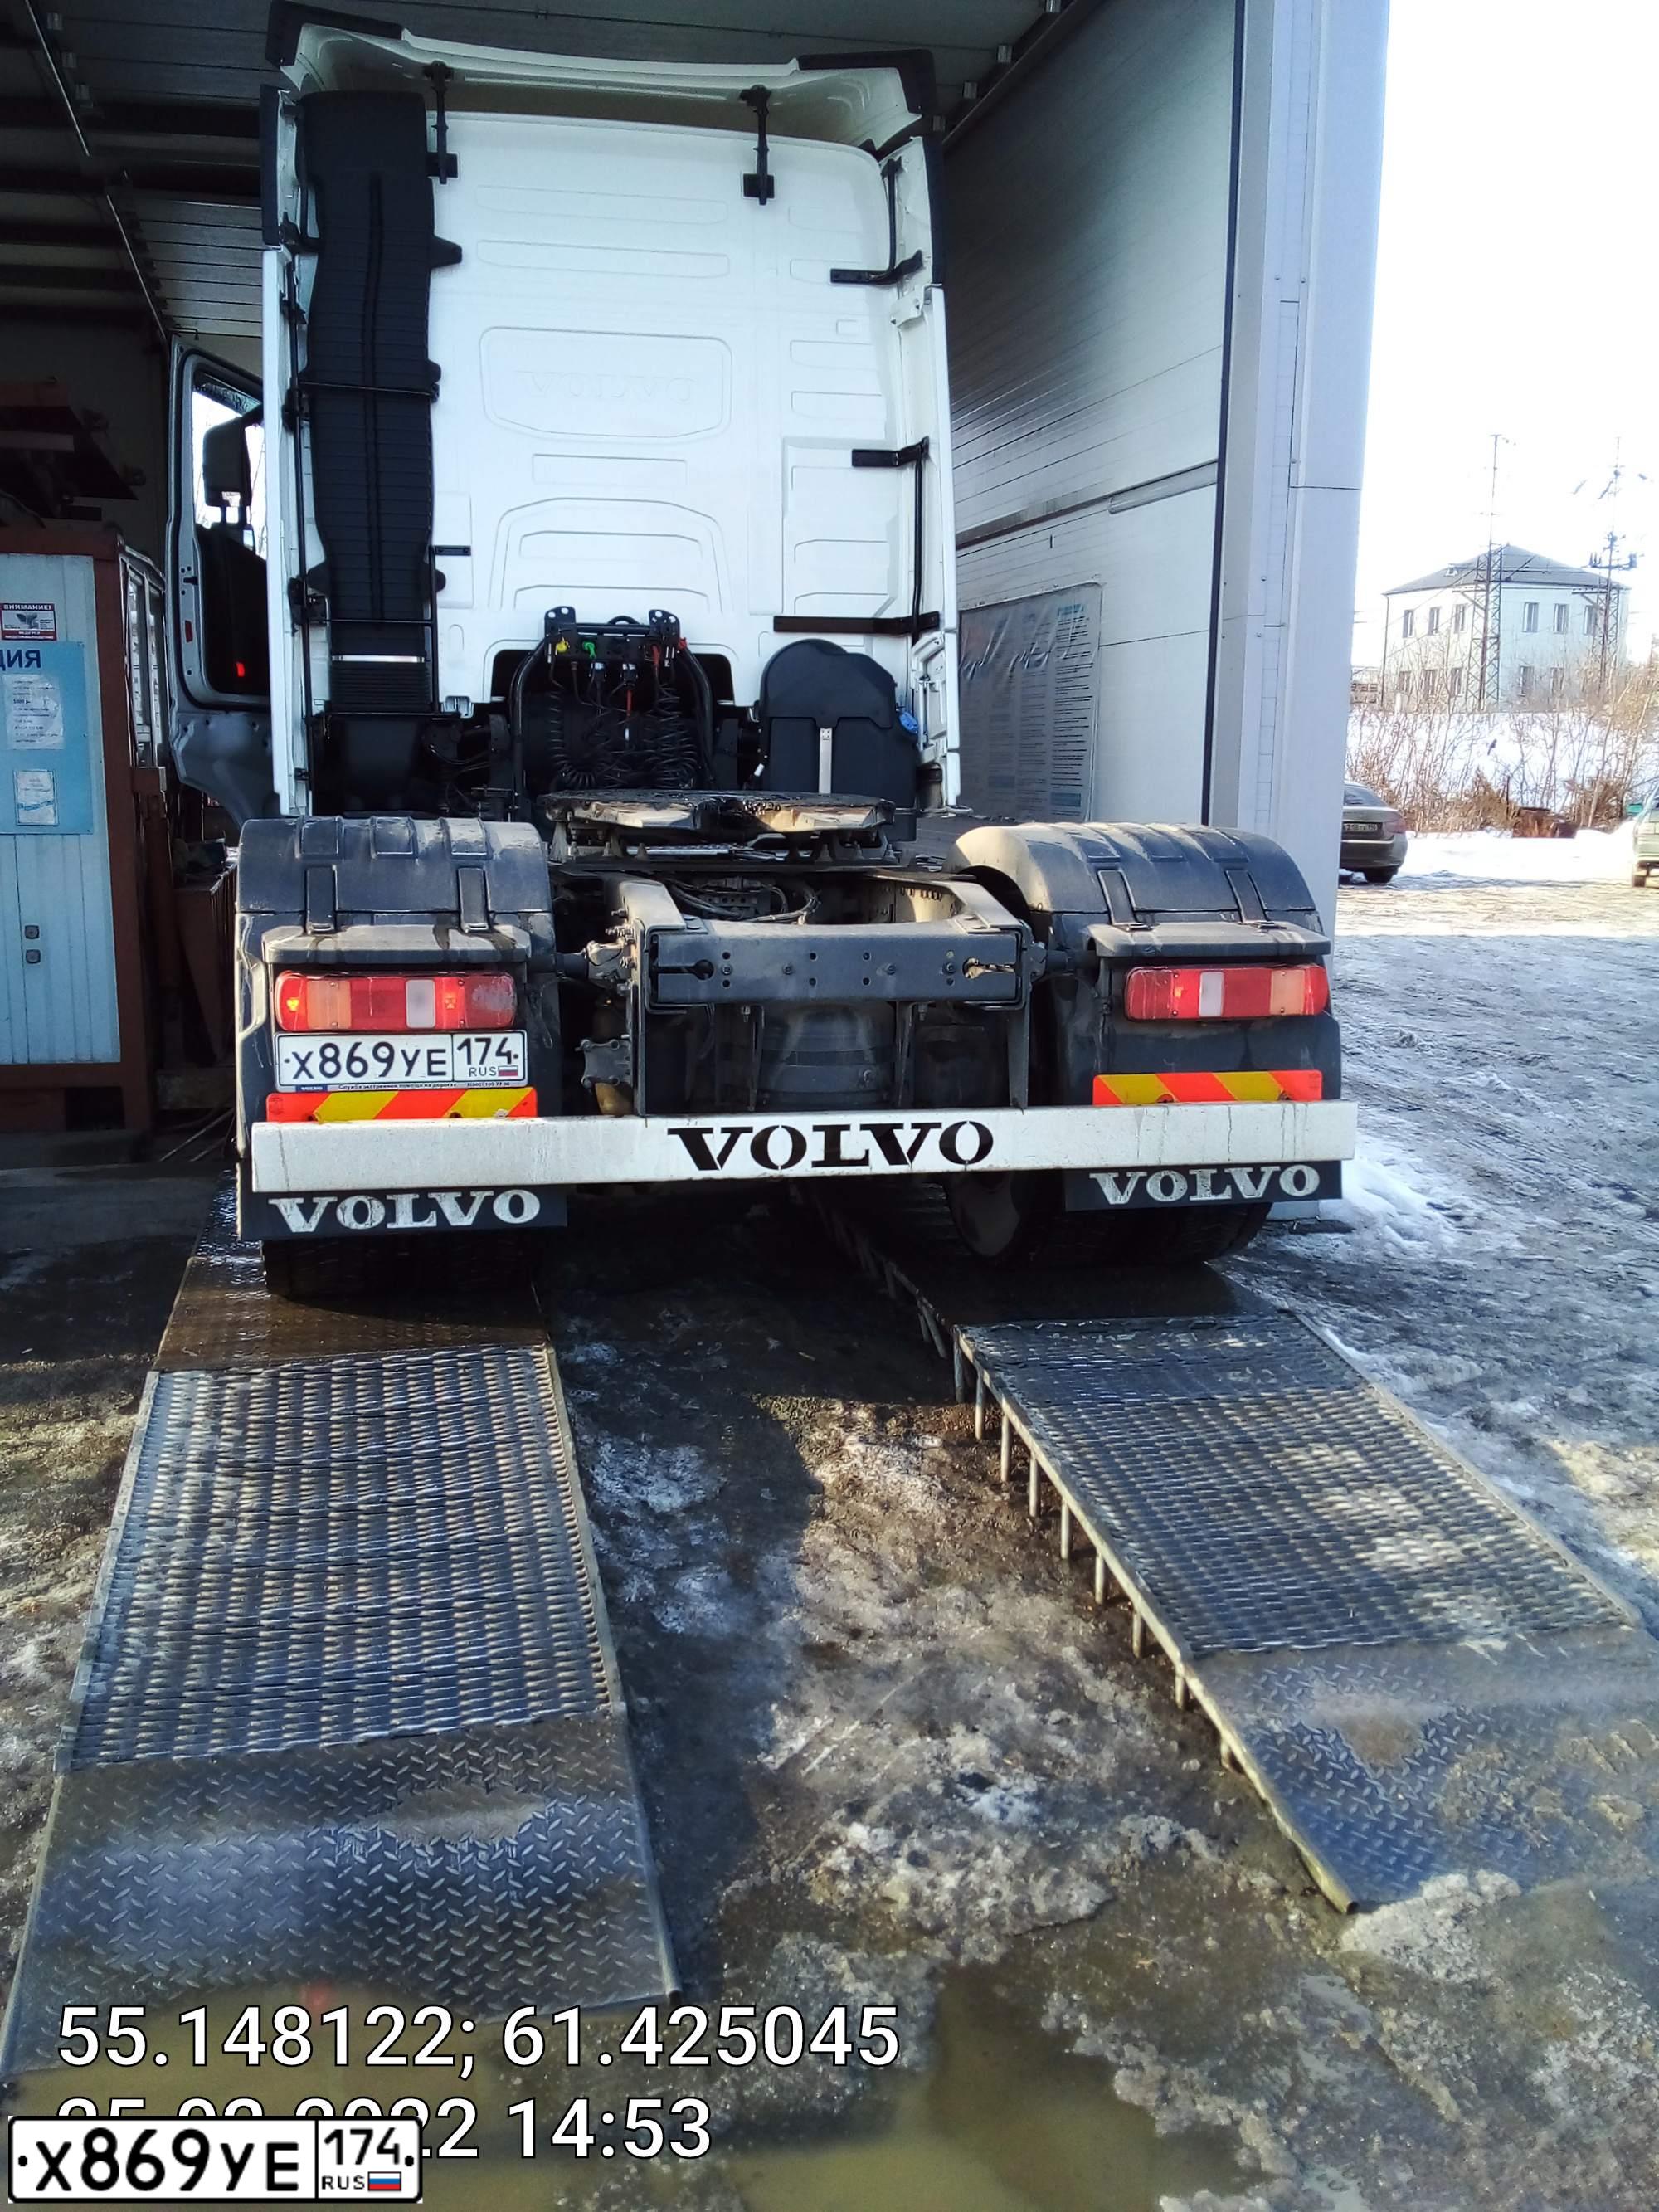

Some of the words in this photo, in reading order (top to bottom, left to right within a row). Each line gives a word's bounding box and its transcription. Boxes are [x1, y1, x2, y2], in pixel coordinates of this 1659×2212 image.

[291, 1041, 448, 1080] Х869УЕ
[456, 1037, 512, 1066] 174
[468, 1065, 497, 1077] RUS
[668, 1120, 995, 1171] VOLVO
[1089, 1165, 1320, 1205] VOLVO
[268, 1189, 541, 1233] VOLVO
